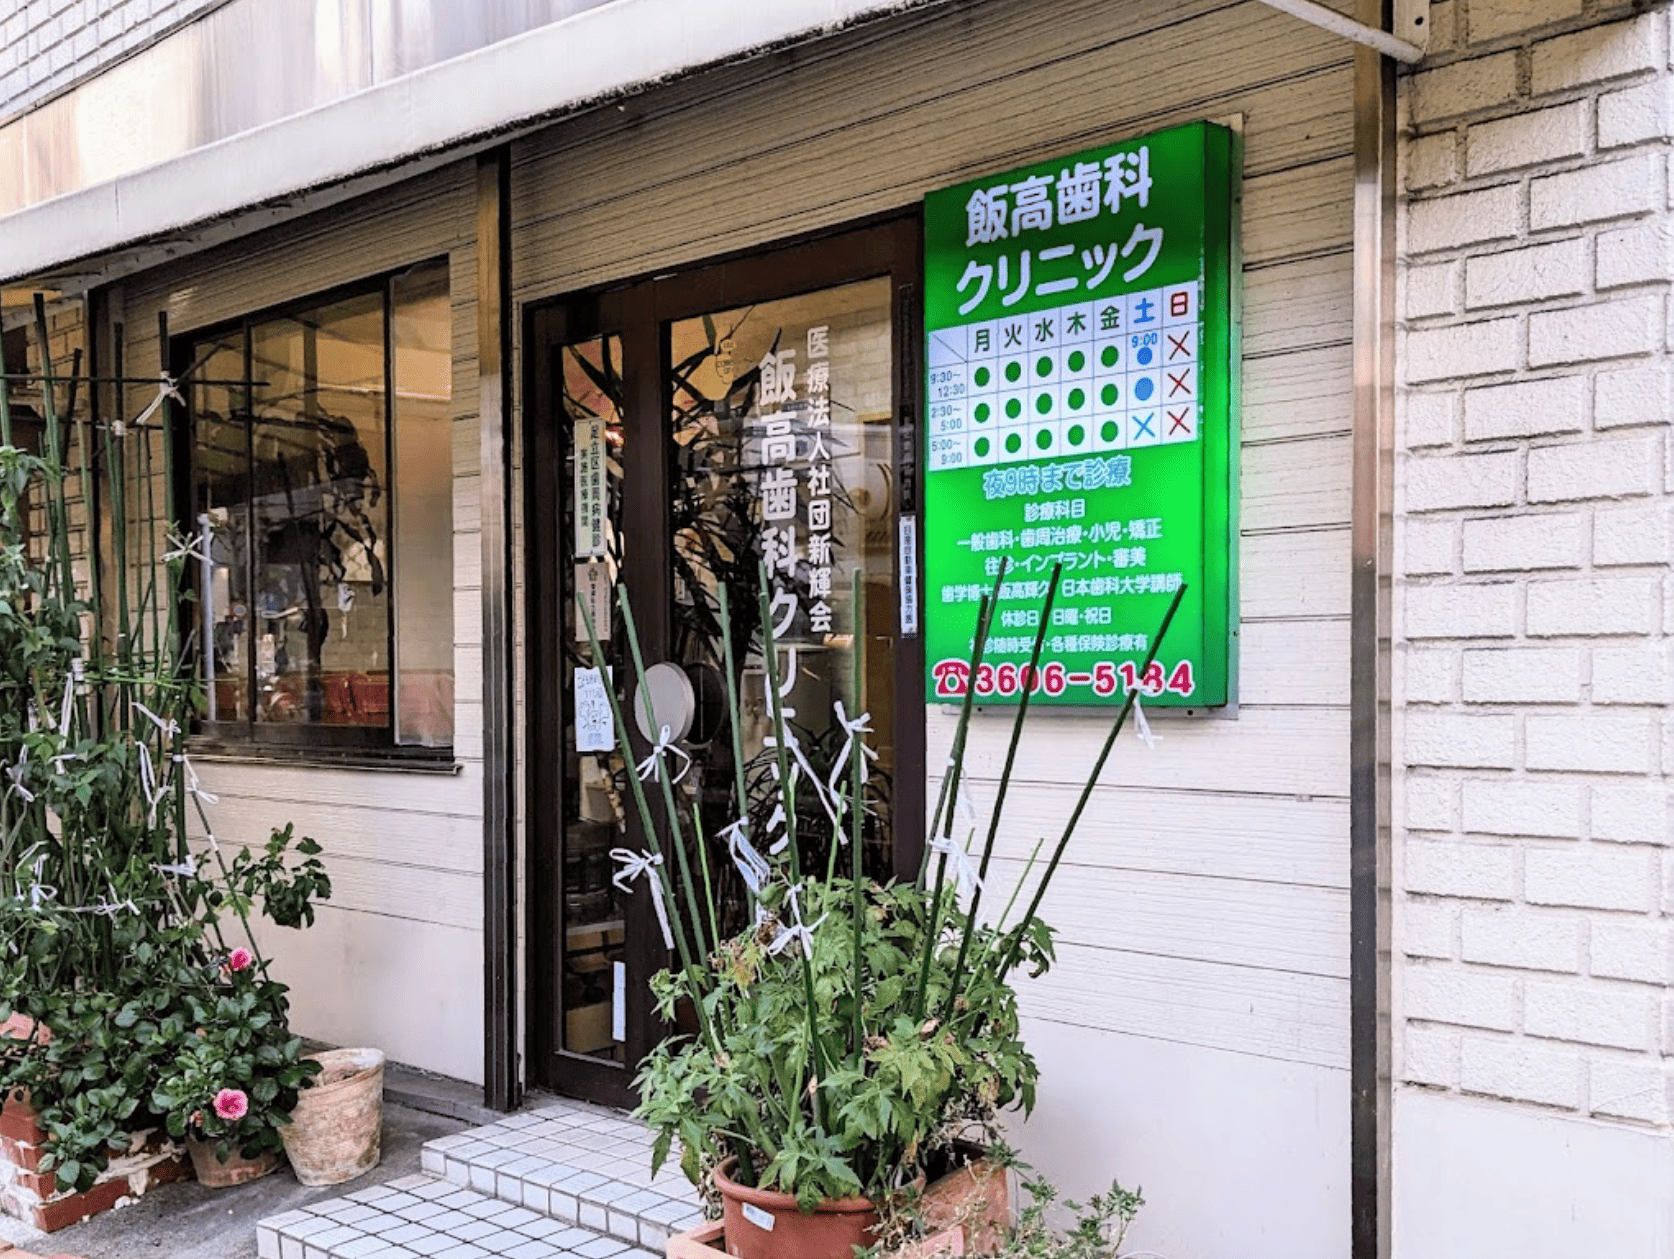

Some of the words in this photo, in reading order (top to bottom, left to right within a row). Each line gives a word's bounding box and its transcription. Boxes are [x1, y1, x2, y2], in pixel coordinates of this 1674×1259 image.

[966, 145, 1152, 247] 飯高歯科
[956, 223, 1164, 315] クリニック
[975, 328, 990, 353] 月
[1004, 323, 1022, 348] 火
[1035, 317, 1054, 342] 水
[1067, 311, 1086, 335] 木
[1100, 305, 1120, 330] 金
[1133, 297, 1156, 324] 土
[1170, 291, 1189, 318] 日
[1131, 332, 1158, 349] 9:00
[806, 325, 833, 634] 医療法人社団新輝会
[983, 454, 1132, 500] 夜9時まで診療
[1024, 498, 1085, 523] 診療科目
